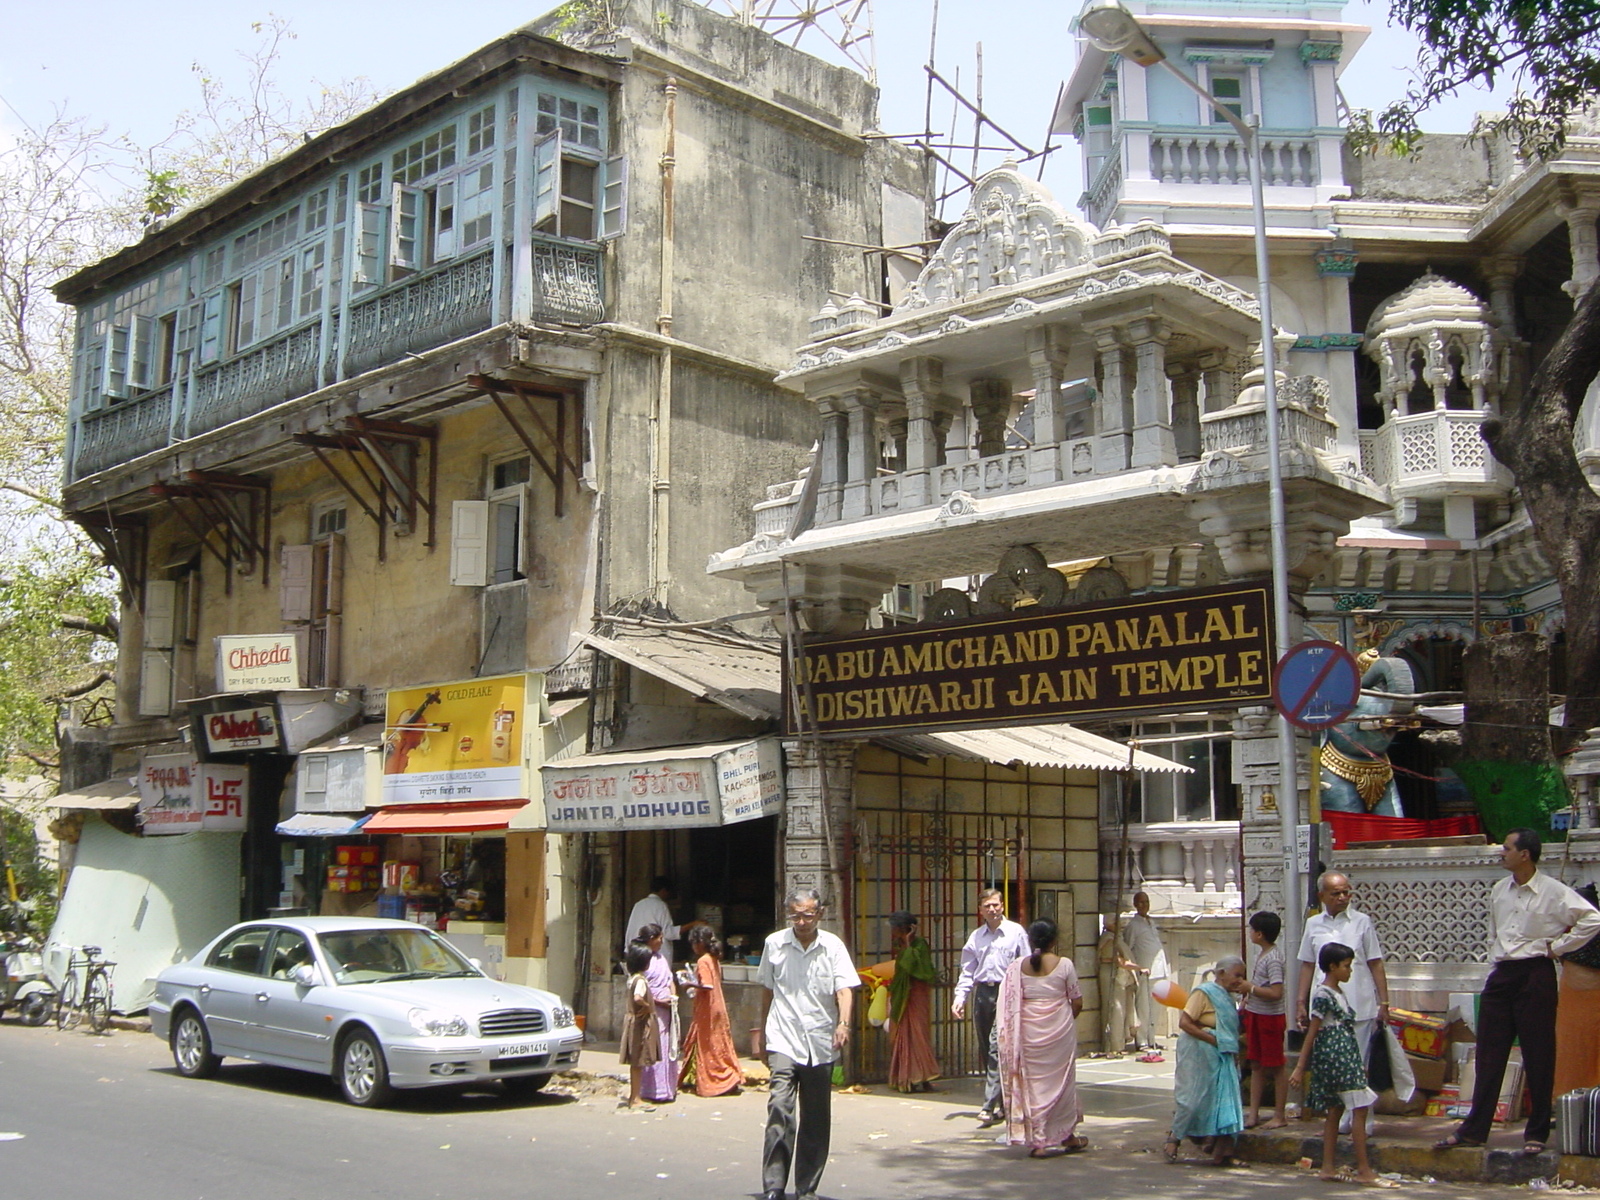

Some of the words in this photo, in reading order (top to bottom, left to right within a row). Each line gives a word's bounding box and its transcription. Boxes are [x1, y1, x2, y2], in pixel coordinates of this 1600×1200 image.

[794, 649, 875, 685] BABU
[878, 627, 1059, 677] AMICHAND
[1066, 604, 1259, 658] PANALAL
[228, 643, 291, 671] Chheda
[446, 689, 468, 701] GOLD
[468, 686, 493, 699] FLAKE
[794, 677, 995, 724] ADISHWARJI
[1007, 667, 1098, 706] JAIN
[1111, 650, 1263, 697] TEMPLE
[723, 767, 743, 780] BHEL
[744, 762, 760, 774] PURI
[552, 806, 615, 821] JANTA
[623, 800, 710, 819] UDHYOG
